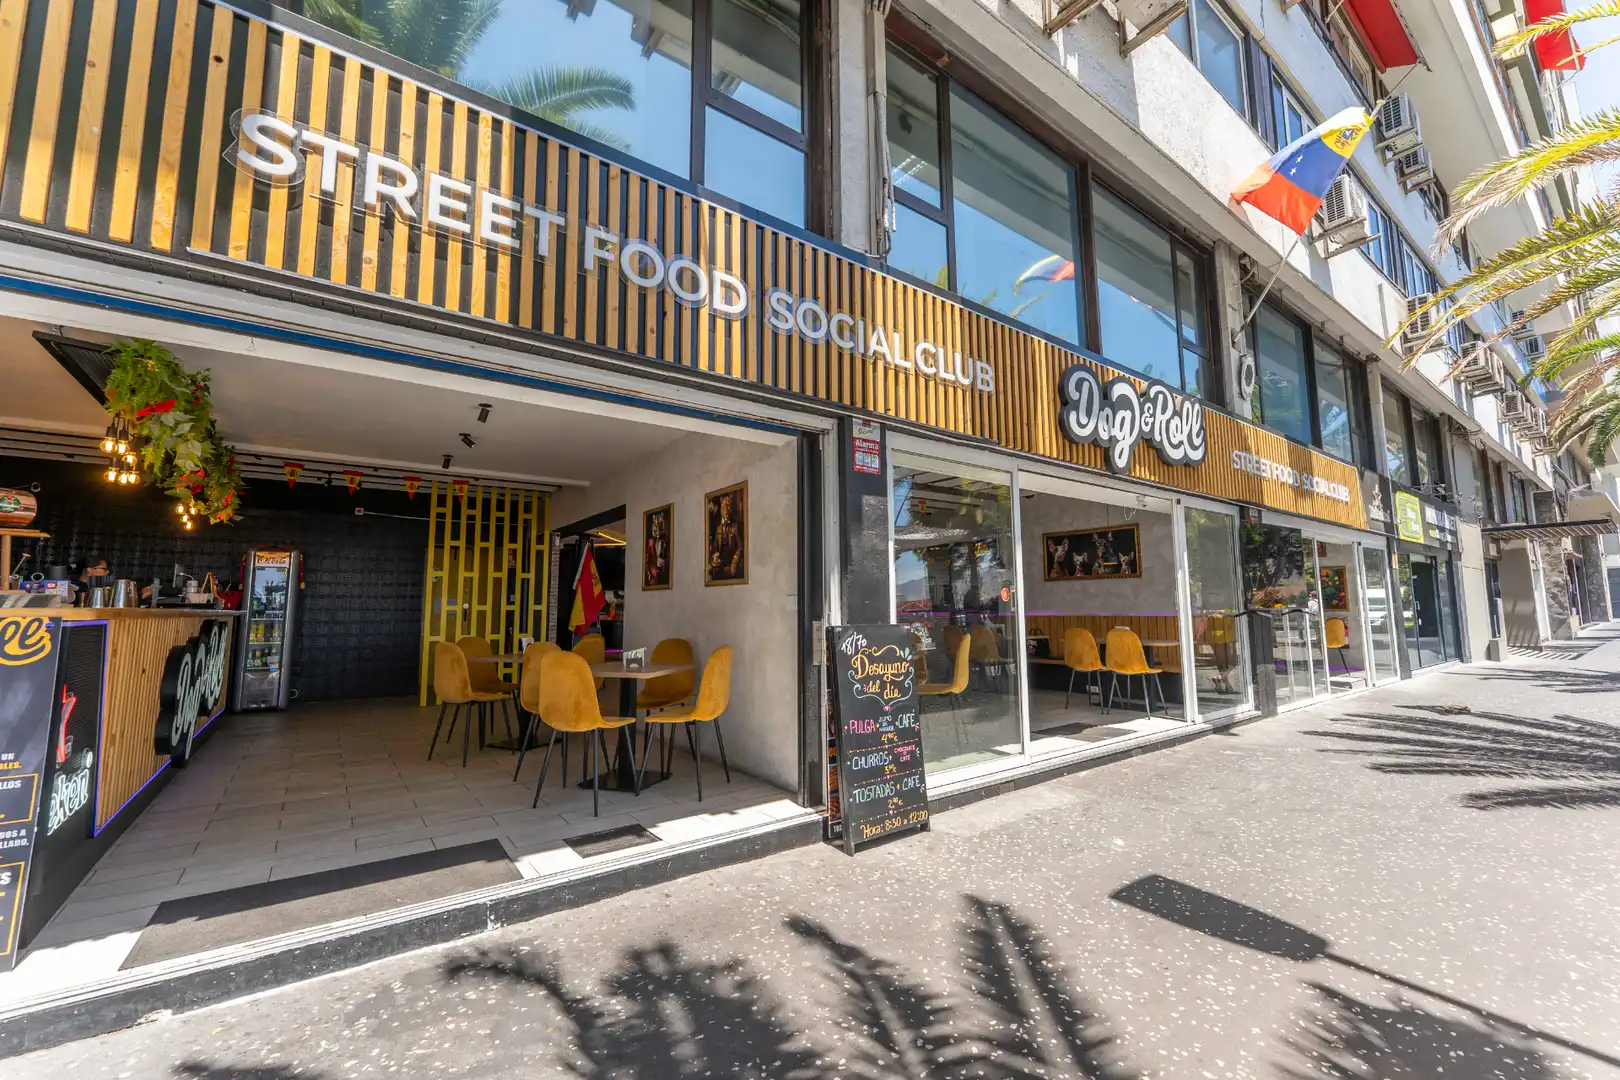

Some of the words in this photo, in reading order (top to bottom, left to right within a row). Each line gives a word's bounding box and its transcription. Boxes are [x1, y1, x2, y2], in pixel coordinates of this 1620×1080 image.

[237, 114, 565, 257] STREET
[584, 229, 747, 315] FOOD
[769, 290, 912, 369] SOCIAL
[914, 341, 995, 392] CLUB
[1232, 450, 1271, 479] STREET
[1273, 463, 1300, 487] FOOD
[851, 653, 910, 682] Desayuno
[866, 680, 880, 693] del
[849, 719, 876, 734] PULGA
[897, 709, 916, 728] CAFÉ
[852, 751, 889, 770] CHURROS
[853, 782, 896, 803] TOSTADAS
[902, 771, 921, 791] CAFÉ
[860, 823, 884, 839] Hora:
[885, 816, 901, 830] 8:30
[909, 810, 928, 824] 12:00
